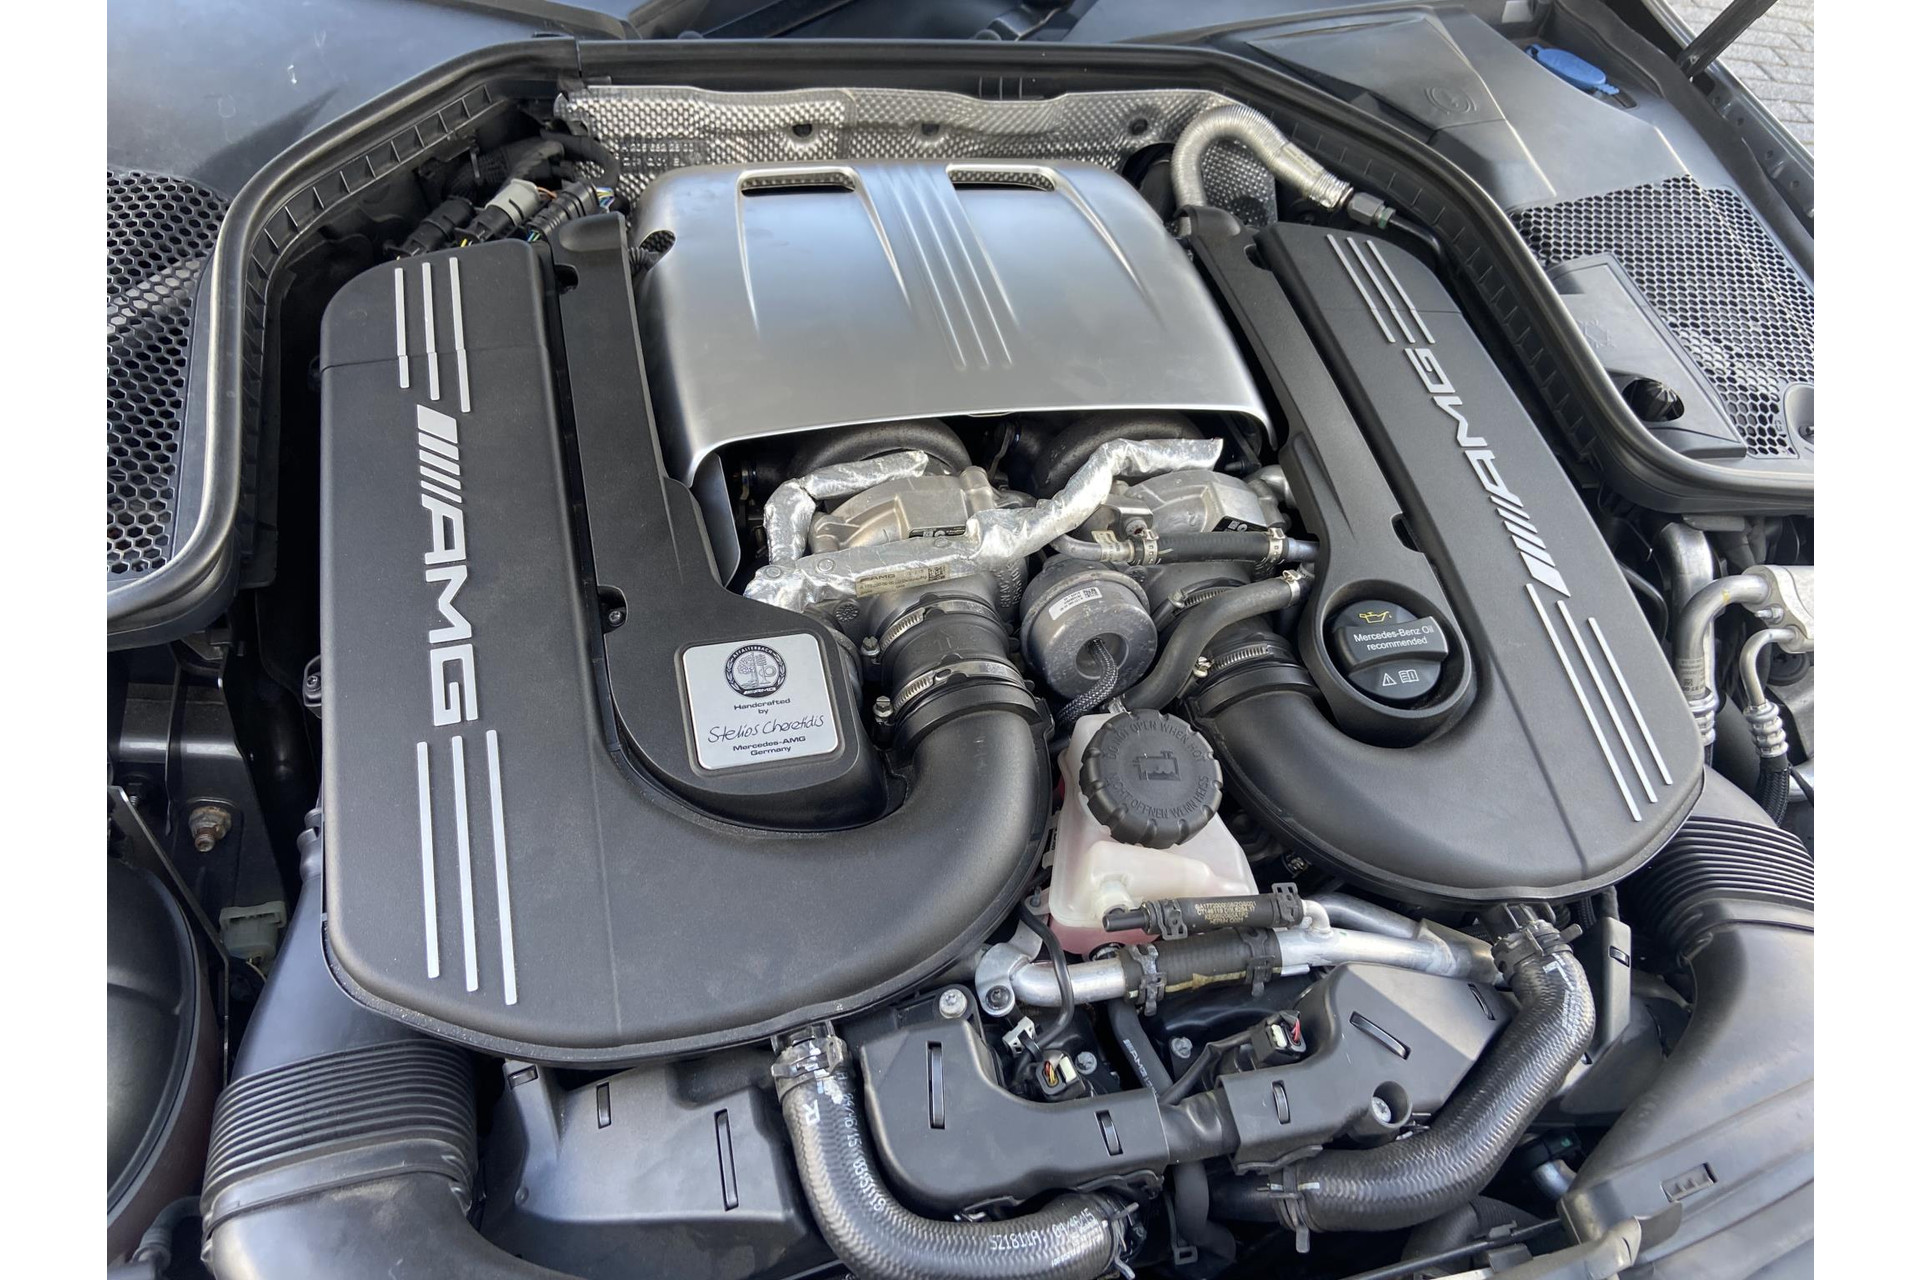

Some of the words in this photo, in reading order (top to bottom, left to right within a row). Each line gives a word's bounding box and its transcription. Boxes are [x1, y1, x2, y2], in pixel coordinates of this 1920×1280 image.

[1404, 348, 1524, 508] AMG
[421, 493, 479, 727] AMG
[1353, 627, 1422, 643] Mercedes-Benz
[1421, 624, 1434, 634] Oil
[1366, 636, 1428, 651] recommended
[733, 697, 791, 710] Handcrafted
[707, 723, 759, 743] Stelios
[1128, 719, 1159, 733] OPEN
[1159, 721, 1190, 745] WHEN
[732, 735, 807, 752] Mercedes-AMG
[750, 746, 792, 756] Germany
[1168, 800, 1199, 820] WENN
[1195, 774, 1210, 804] HEISS
